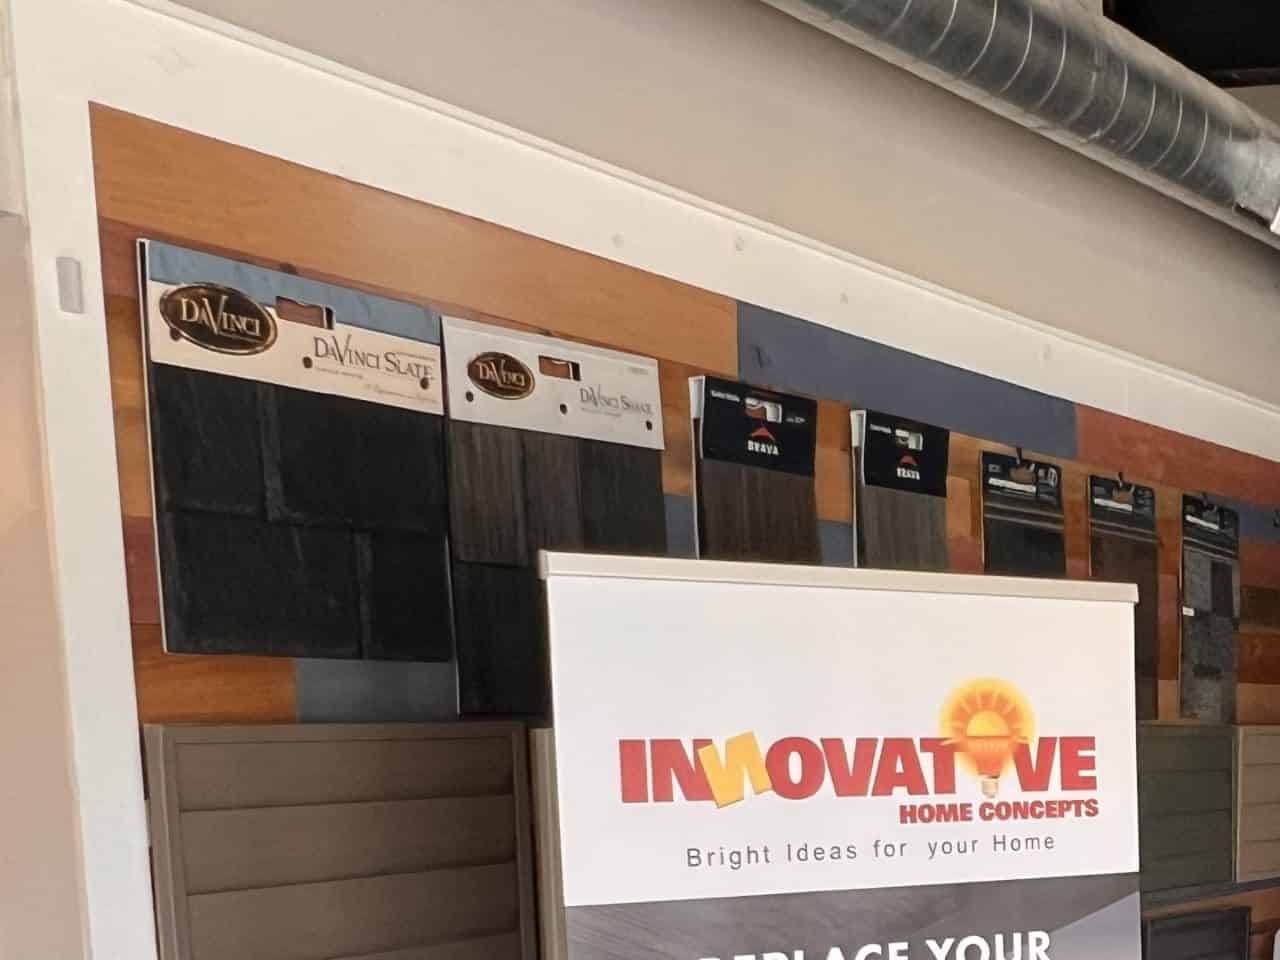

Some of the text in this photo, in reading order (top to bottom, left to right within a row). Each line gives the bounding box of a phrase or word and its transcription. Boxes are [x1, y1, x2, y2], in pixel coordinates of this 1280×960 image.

[747, 440, 779, 456] BRAVA
[899, 798, 1099, 824] HOME CONCEPTS
[687, 834, 1056, 869] Bright Ideas for your Home
